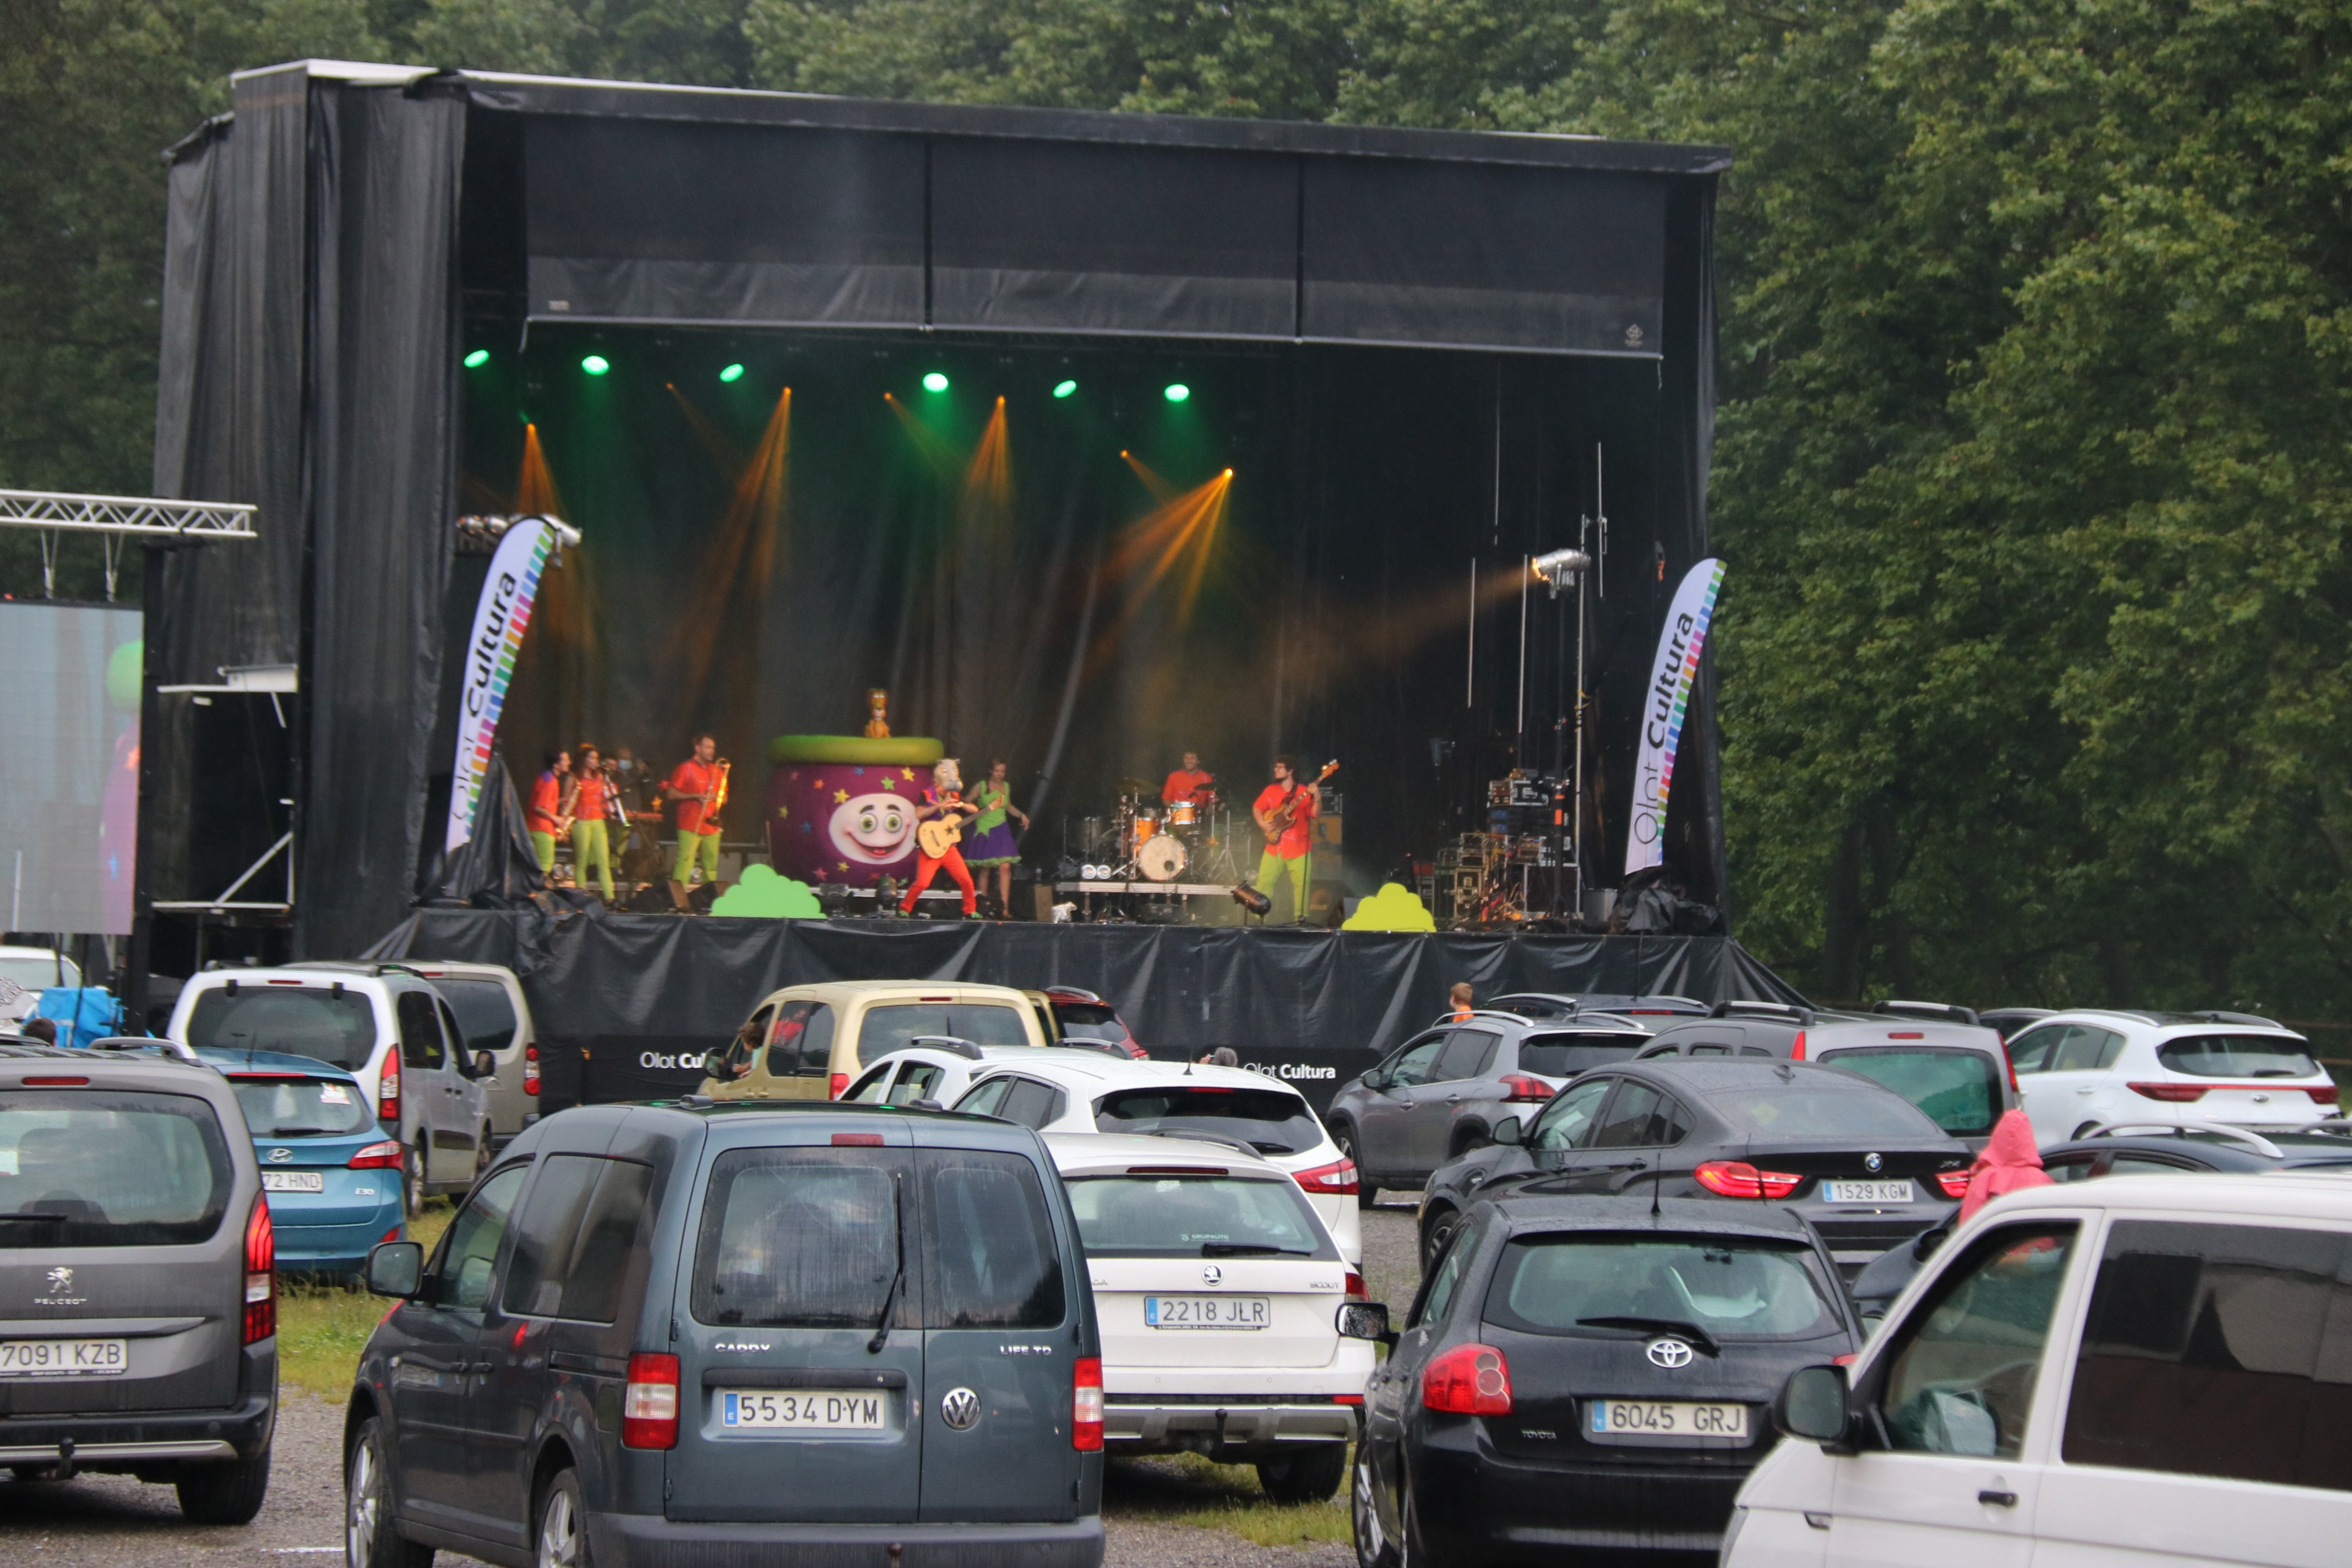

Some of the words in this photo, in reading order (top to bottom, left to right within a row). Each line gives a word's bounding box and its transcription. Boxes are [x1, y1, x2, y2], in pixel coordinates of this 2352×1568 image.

[467, 573, 516, 717] Cultura
[1634, 762, 1658, 844] Olot
[1647, 612, 1694, 750] Cultura
[639, 1052, 677, 1069] Olot
[678, 1052, 706, 1069] Cul
[1244, 1063, 1277, 1077] Olot
[1280, 1064, 1336, 1079] Cultura
[288, 1174, 319, 1188] HND
[1837, 1184, 1874, 1199] 1529
[1880, 1184, 1909, 1199] KGM
[1163, 1301, 1217, 1321] 2218
[1226, 1302, 1264, 1322] JLR
[3, 1344, 62, 1366] 7091
[75, 1343, 121, 1365] KZB
[715, 1343, 770, 1353] CADDY
[1000, 1345, 1029, 1355] LIFE
[741, 1396, 818, 1422] 5534
[827, 1398, 878, 1424] DYM
[1612, 1404, 1675, 1430] 6045
[1694, 1407, 1741, 1432] GRJ
[1522, 1430, 1557, 1440] TOYOTA
